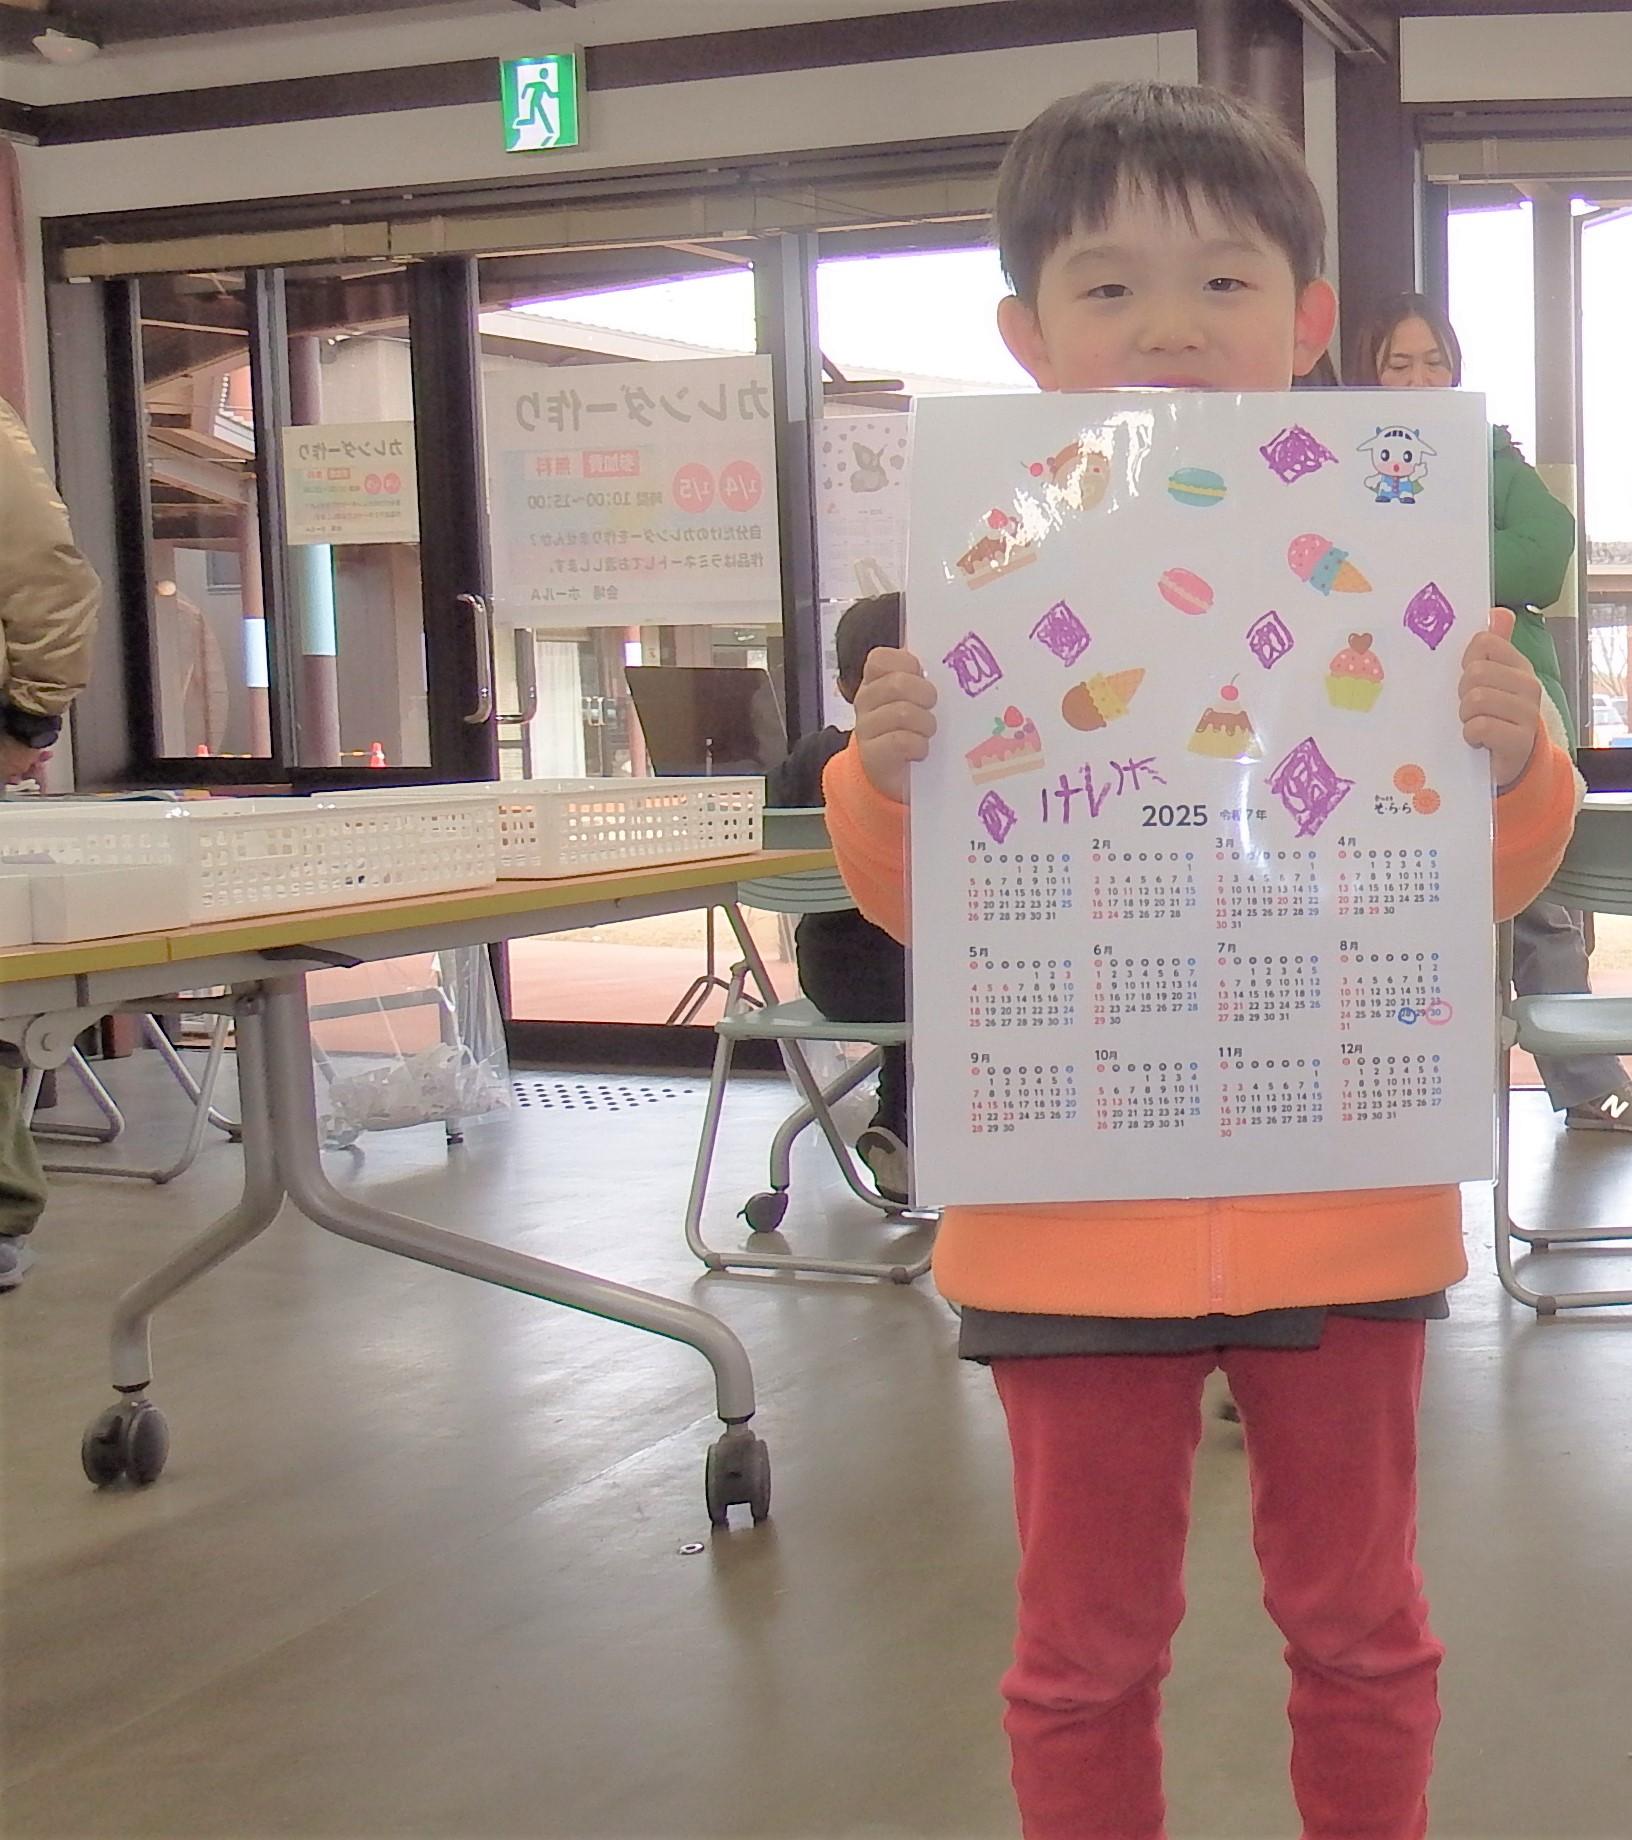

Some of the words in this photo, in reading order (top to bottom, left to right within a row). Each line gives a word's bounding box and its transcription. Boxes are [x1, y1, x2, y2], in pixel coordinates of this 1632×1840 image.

[1142, 804, 1208, 827] 2025
[970, 840, 986, 851] 1月
[1092, 838, 1111, 850] 2月
[1215, 837, 1234, 849] 3月
[1337, 836, 1356, 847] 4月
[1124, 887, 1132, 895] 11
[1155, 887, 1164, 895] 13
[969, 901, 978, 909] 19
[984, 901, 994, 909] 20
[1046, 900, 1056, 908] 24
[1062, 900, 1072, 908] 25
[1384, 895, 1394, 903] 23
[1216, 909, 1226, 917] 23
[1278, 908, 1288, 916] 27
[1293, 908, 1303, 916] 28
[1308, 908, 1319, 916] 29
[1093, 944, 1113, 956] 6月
[1217, 942, 1236, 953] 7月
[1340, 940, 1358, 951] 8月
[969, 947, 988, 957] 5月
[1095, 1005, 1104, 1013] 22
[1110, 1005, 1120, 1013] 23
[1141, 1004, 1151, 1012] 25
[1157, 1004, 1167, 1012] 26
[1172, 1004, 1182, 1012] 27
[1188, 1003, 1198, 1011] 28
[1218, 1047, 1243, 1058] 11月
[1340, 1043, 1363, 1054] 12月
[970, 1052, 990, 1064] 9月
[1094, 1050, 1118, 1061] 10月
[988, 1101, 998, 1109] 15
[1297, 1104, 1306, 1112] 21
[1600, 1094, 1630, 1119] N
